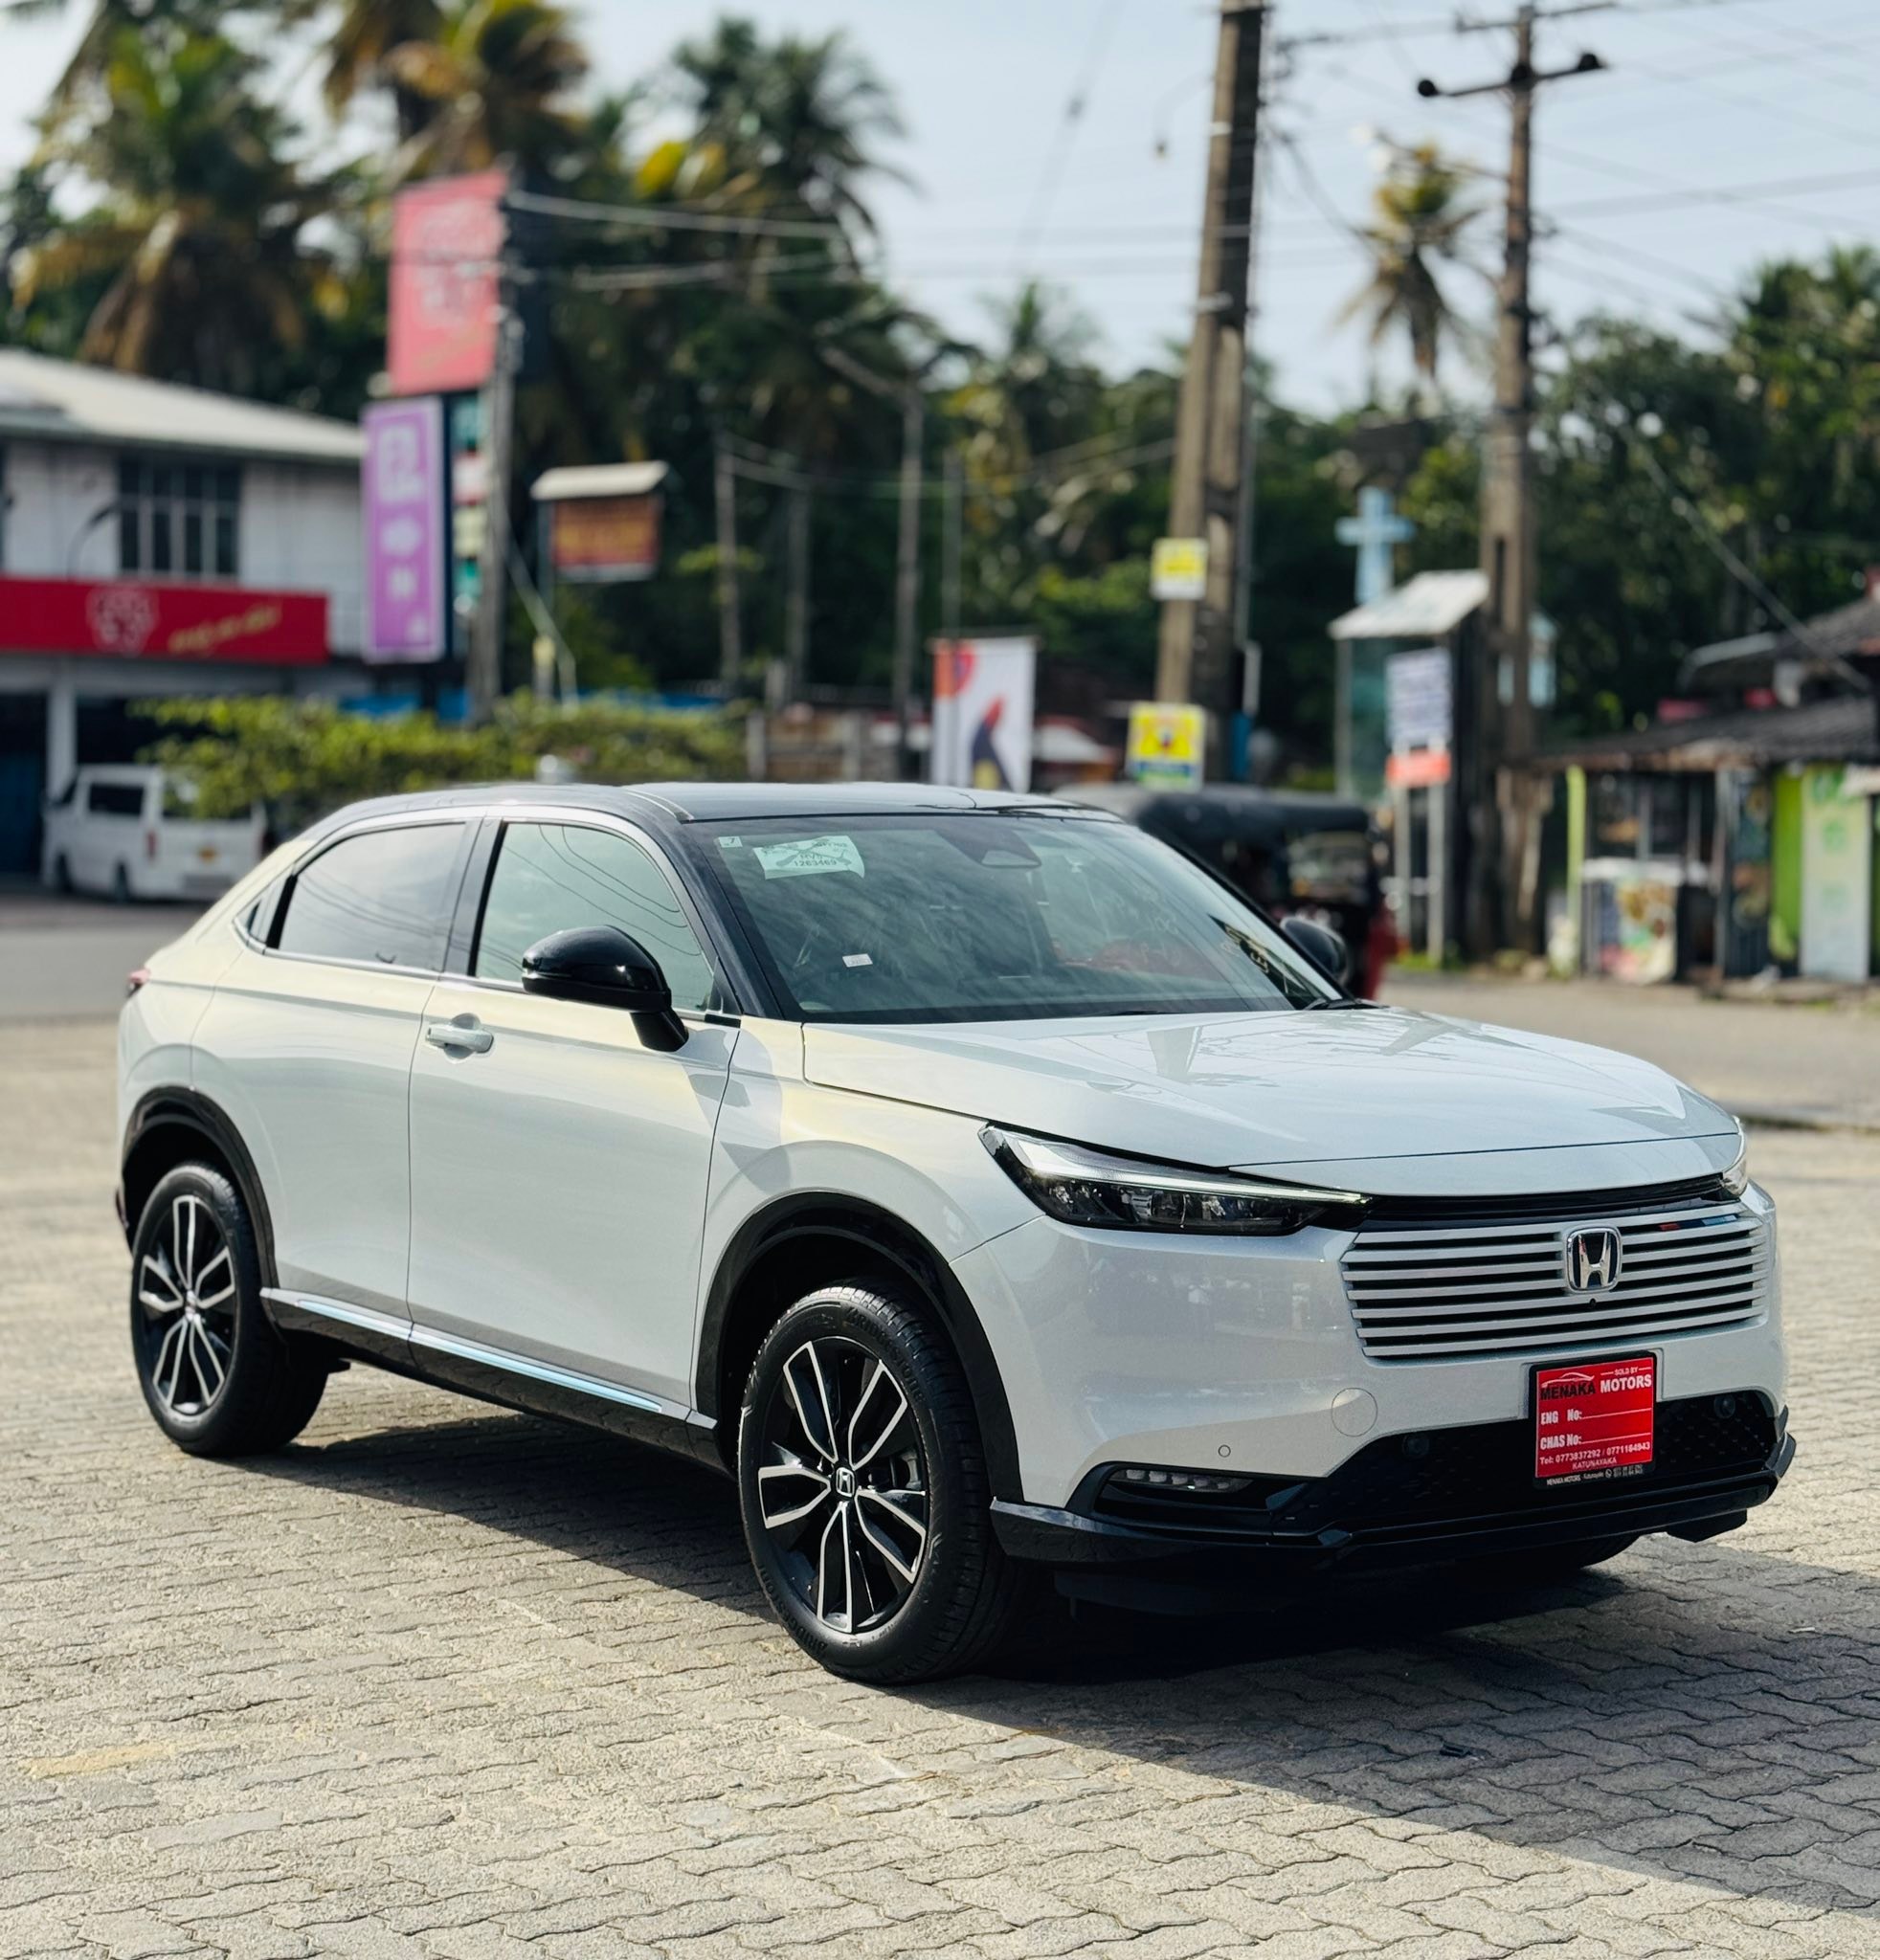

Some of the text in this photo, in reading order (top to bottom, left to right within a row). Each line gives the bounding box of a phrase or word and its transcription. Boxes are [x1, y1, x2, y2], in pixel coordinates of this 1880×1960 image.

[1540, 1374, 1652, 1400] MENAKA MOTORS
[1540, 1411, 1558, 1425] ENG
[1540, 1435, 1566, 1450] CHAS
